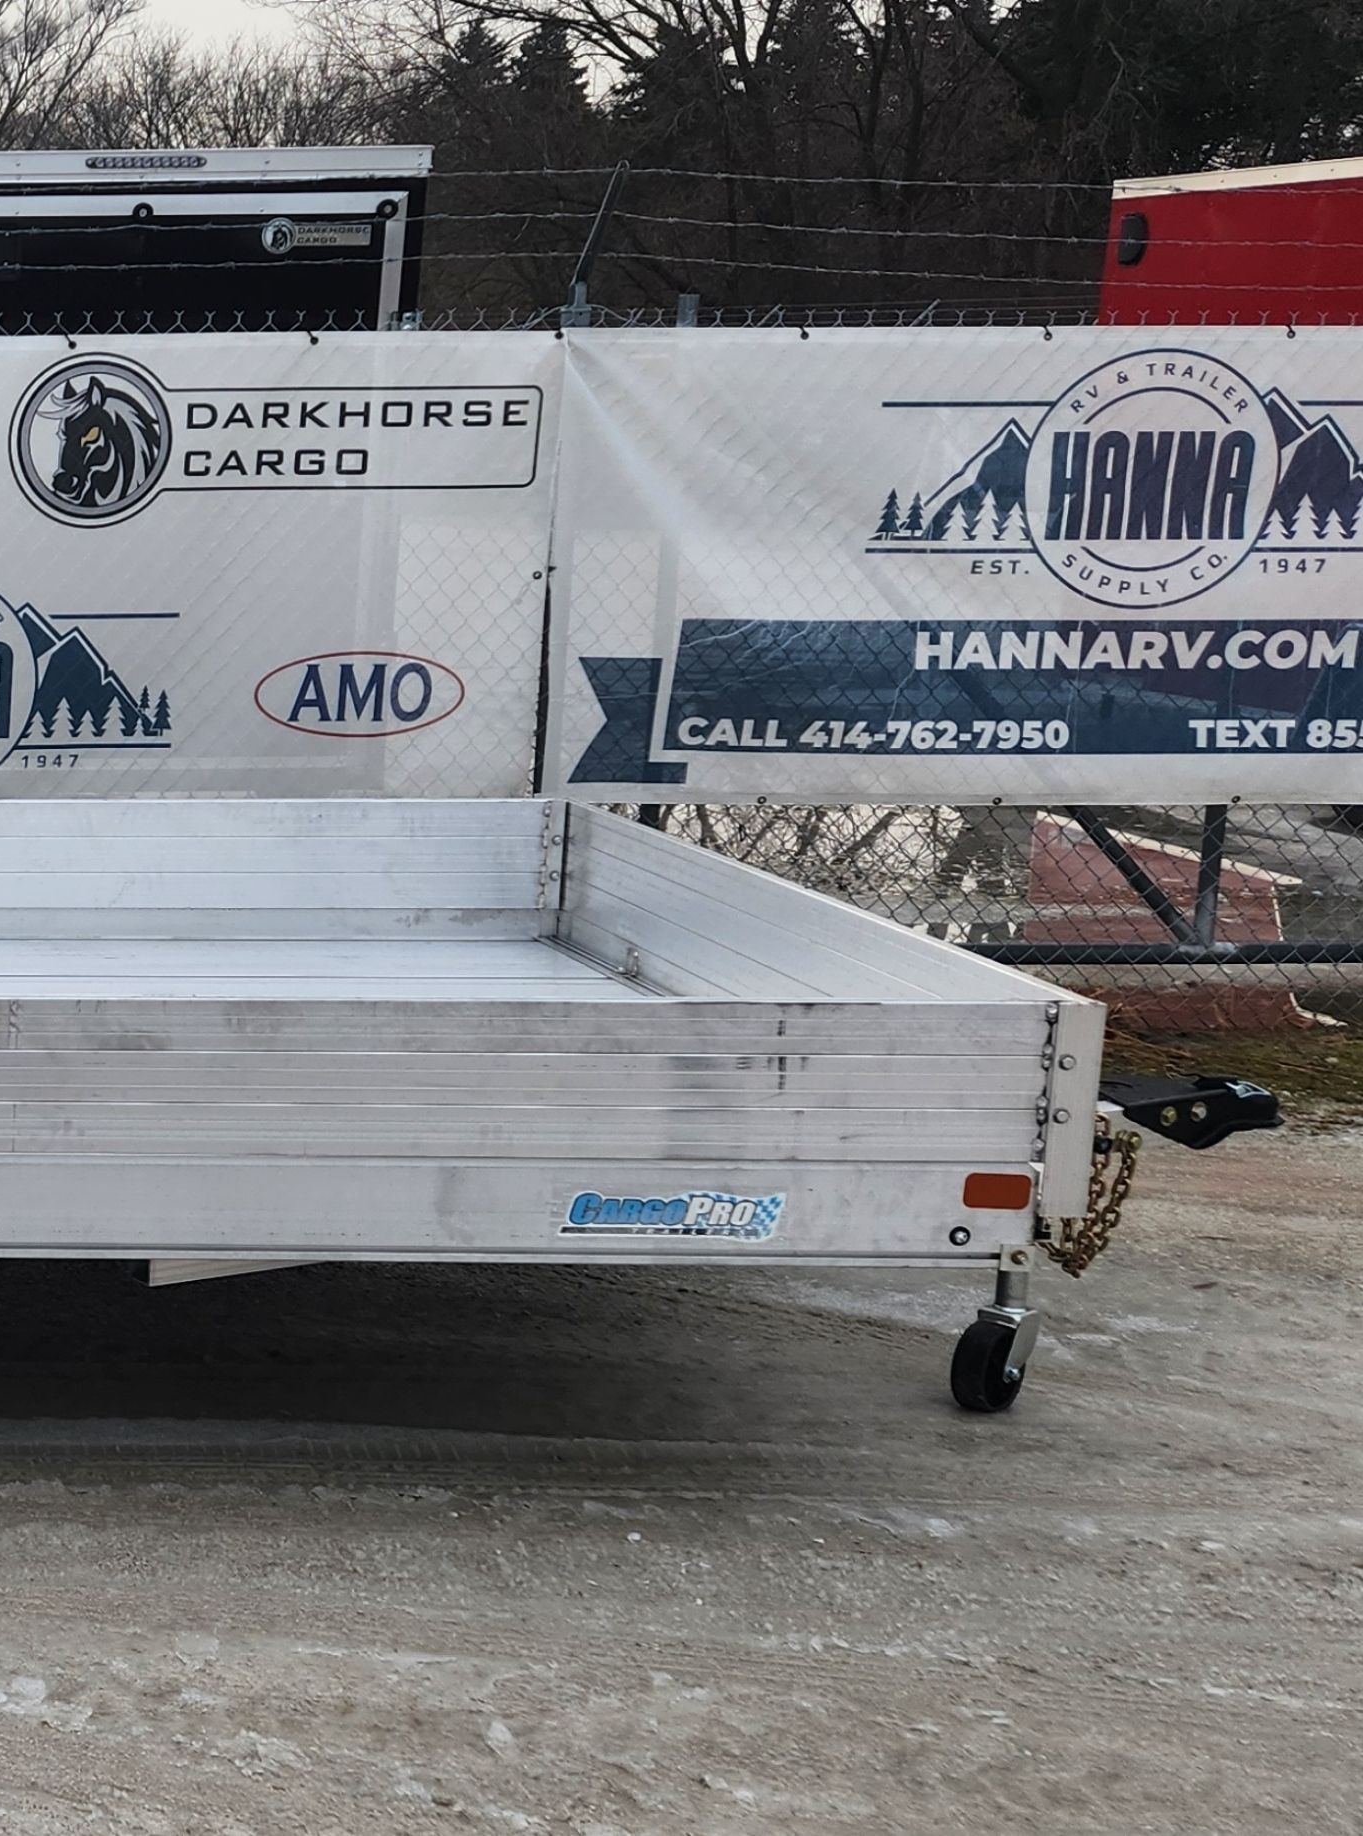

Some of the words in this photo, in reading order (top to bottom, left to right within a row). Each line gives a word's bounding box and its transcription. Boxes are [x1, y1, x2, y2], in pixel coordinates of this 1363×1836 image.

[1070, 385, 1099, 413] RV
[1116, 371, 1129, 384] &
[1146, 363, 1249, 413] TRAILER
[185, 400, 530, 429] DARKHORSE
[183, 449, 370, 476] CARGO
[1044, 430, 1256, 540] HANNA
[970, 560, 1029, 575] EST.
[1062, 554, 1169, 595] SUPPLY
[1190, 554, 1228, 580] CO.
[1259, 559, 1326, 573] 1947
[914, 629, 1360, 671] HANNARV.COM
[287, 663, 433, 722] AMO
[678, 716, 788, 748] CALL
[799, 718, 1071, 750] 414-762-7950
[1188, 719, 1296, 748] TEXT
[21, 754, 79, 768] 1947
